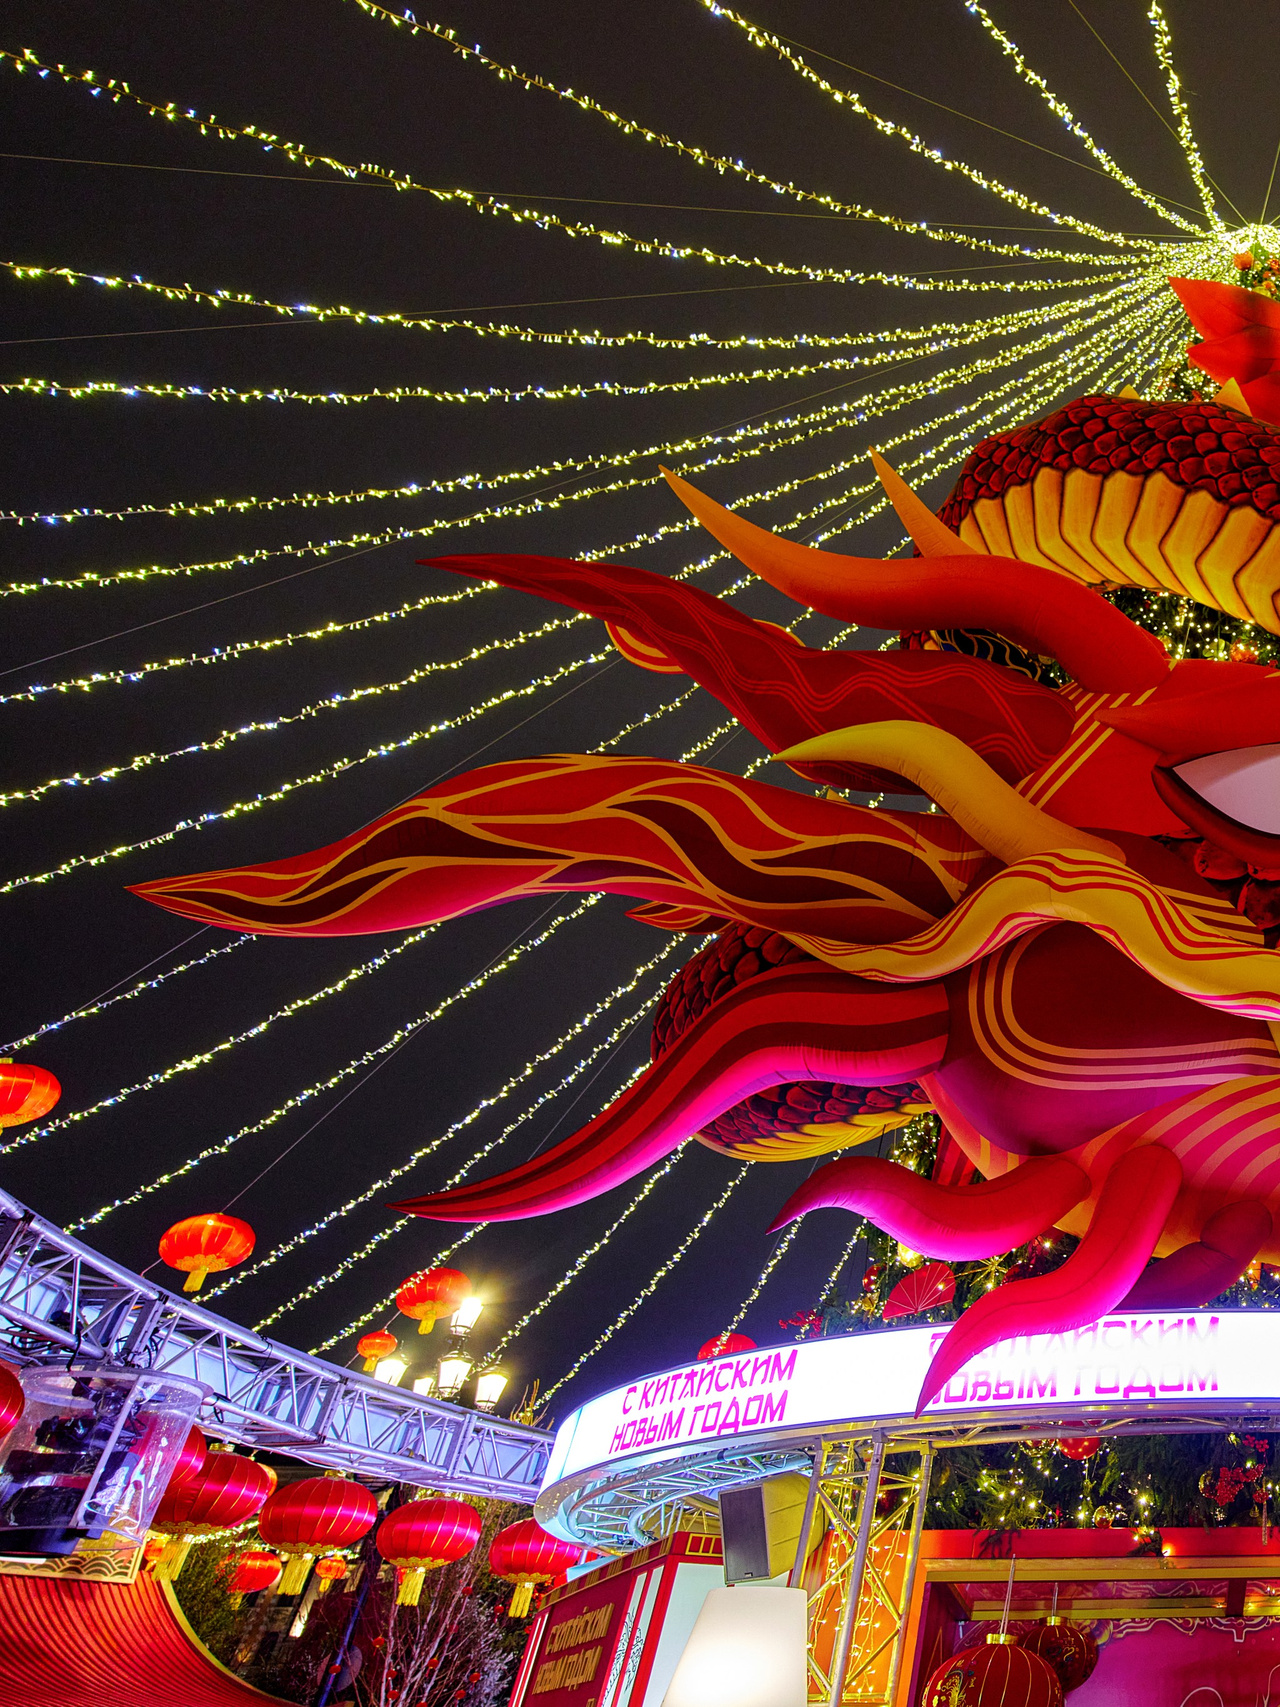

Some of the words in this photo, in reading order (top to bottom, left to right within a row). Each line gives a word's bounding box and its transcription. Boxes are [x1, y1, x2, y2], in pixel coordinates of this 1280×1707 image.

[622, 1386, 637, 1415] С
[638, 1349, 798, 1411] КИТАЙСКИМ
[932, 1366, 1056, 1404] ОВЫМ
[1073, 1364, 1218, 1398] ГОДОМ
[608, 1407, 685, 1454] НОВЫМ
[688, 1390, 788, 1436] ГОДОМ
